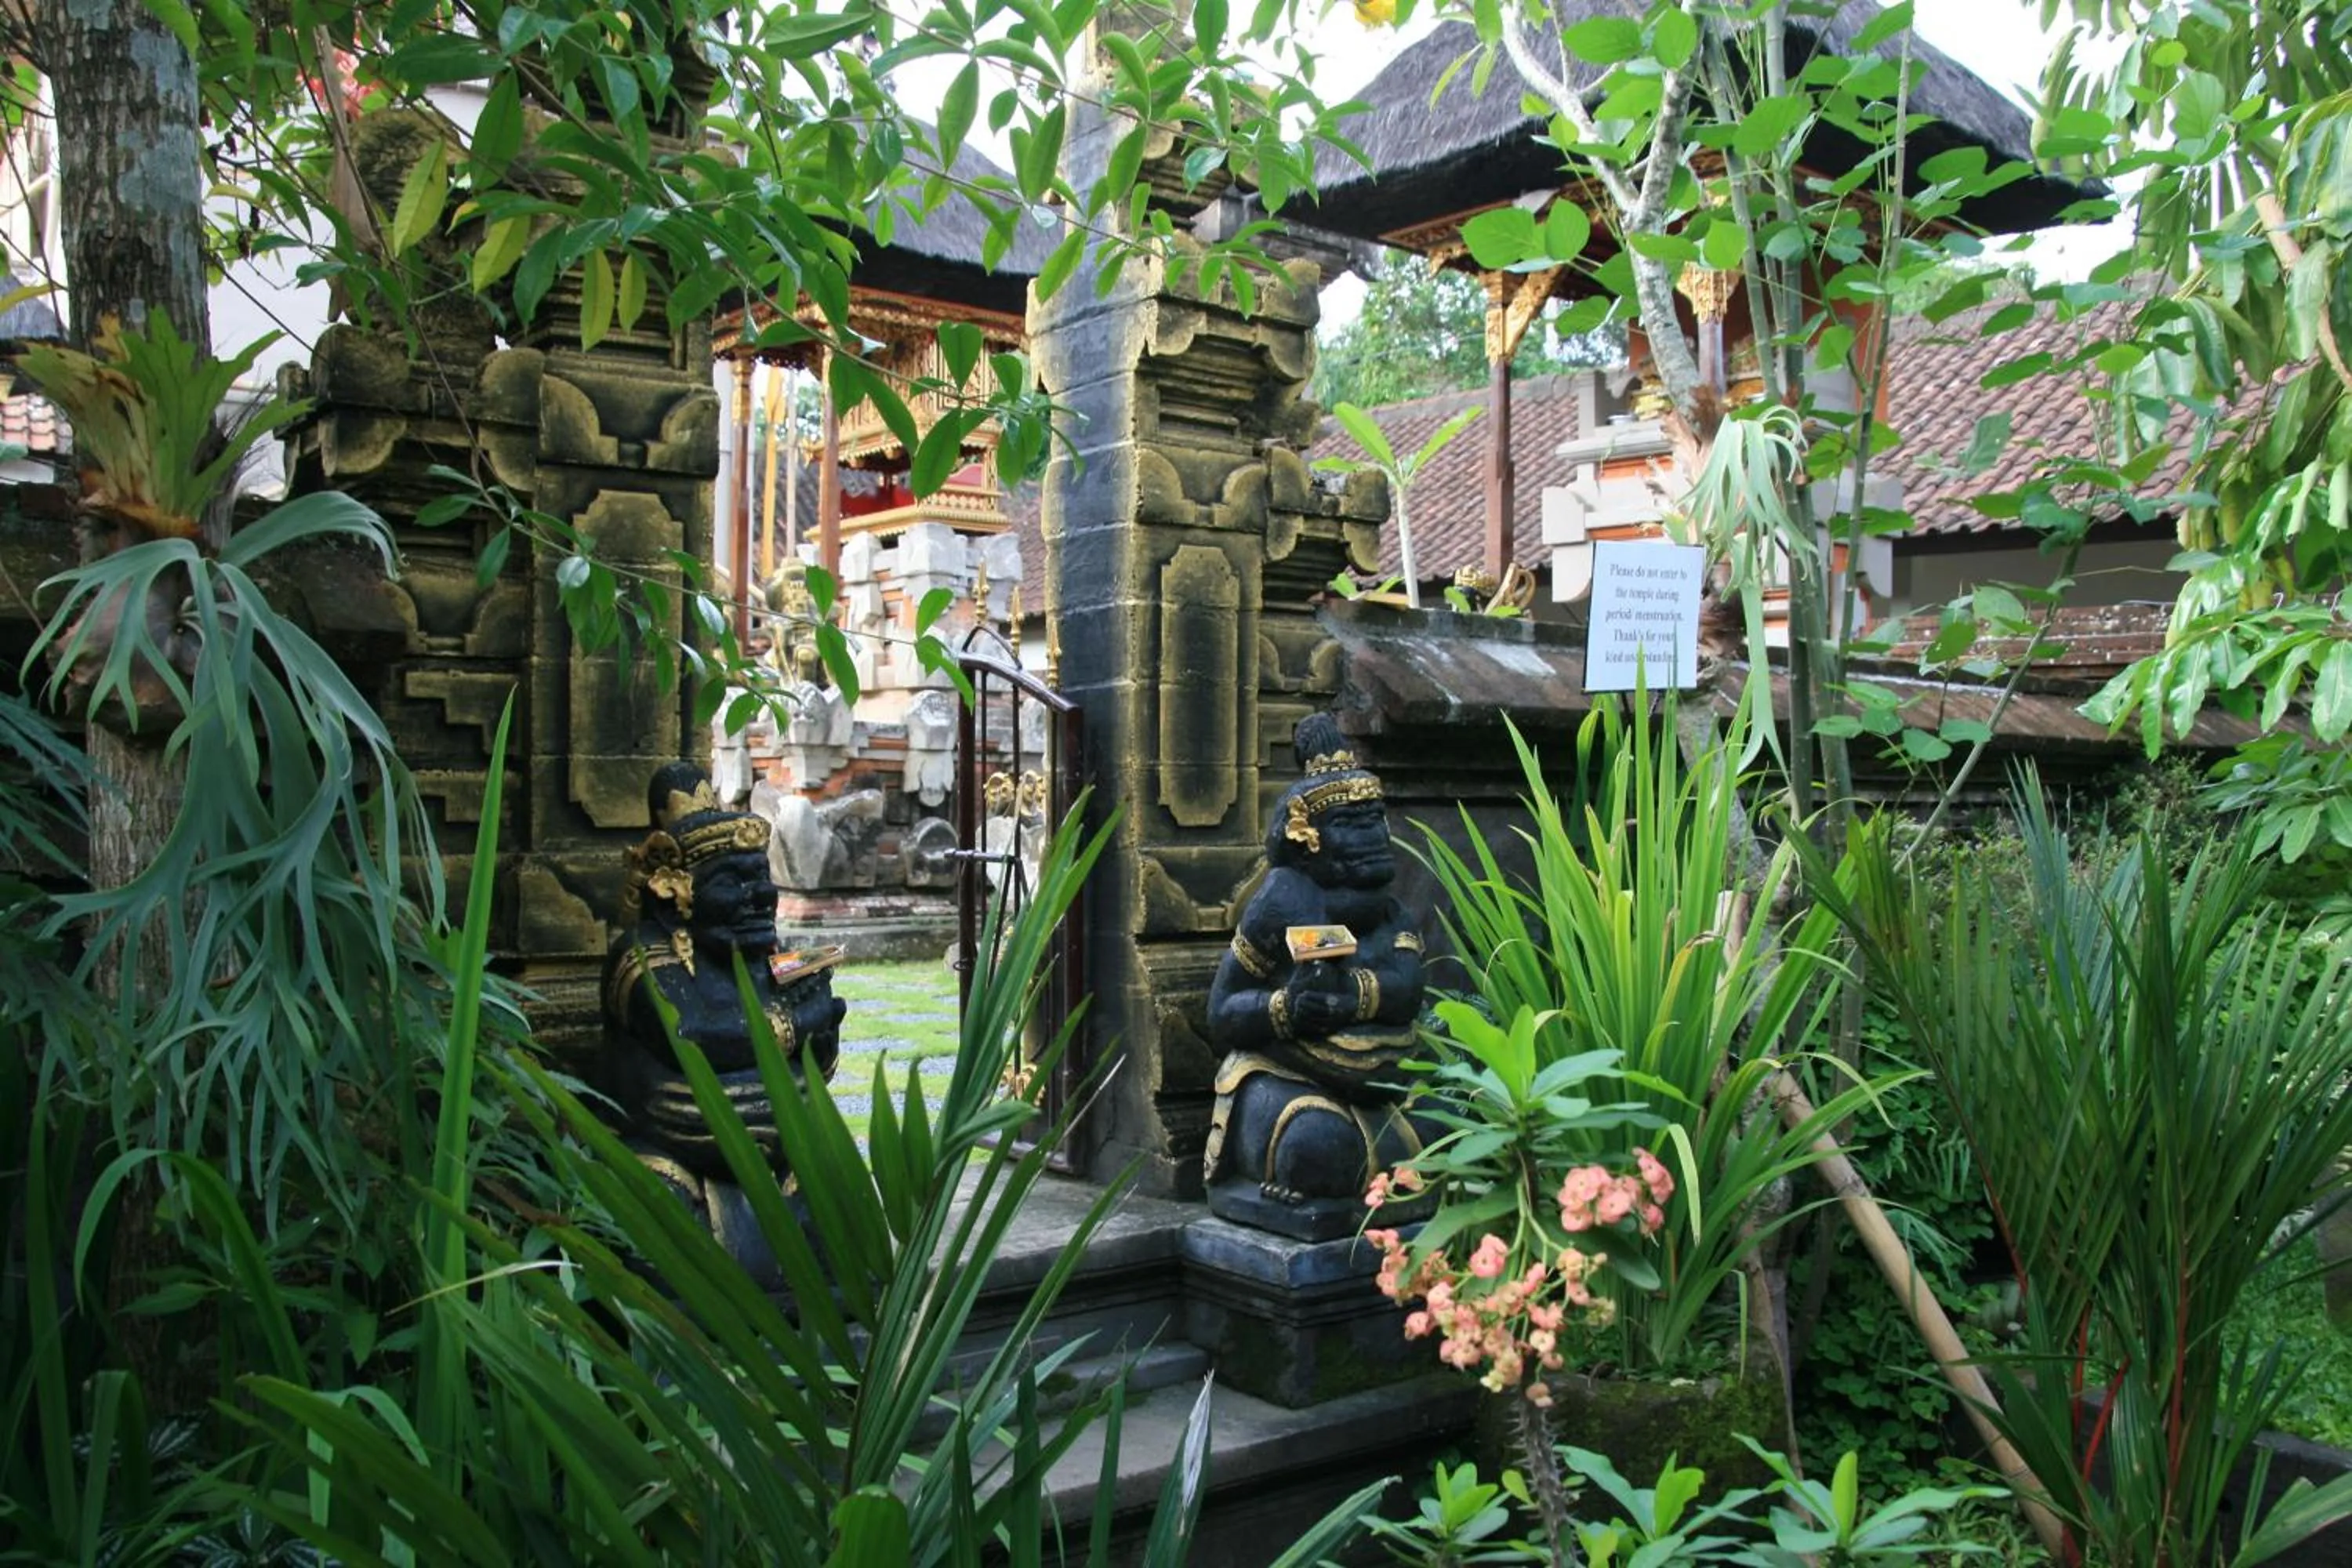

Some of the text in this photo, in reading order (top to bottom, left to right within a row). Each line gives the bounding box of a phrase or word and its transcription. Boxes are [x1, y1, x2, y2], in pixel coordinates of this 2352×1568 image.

[1610, 564, 1634, 578] Please
[1635, 565, 1645, 577] do
[1646, 568, 1658, 578] not
[1655, 589, 1680, 604] during
[1606, 608, 1632, 622] period
[1645, 630, 1656, 641] for
